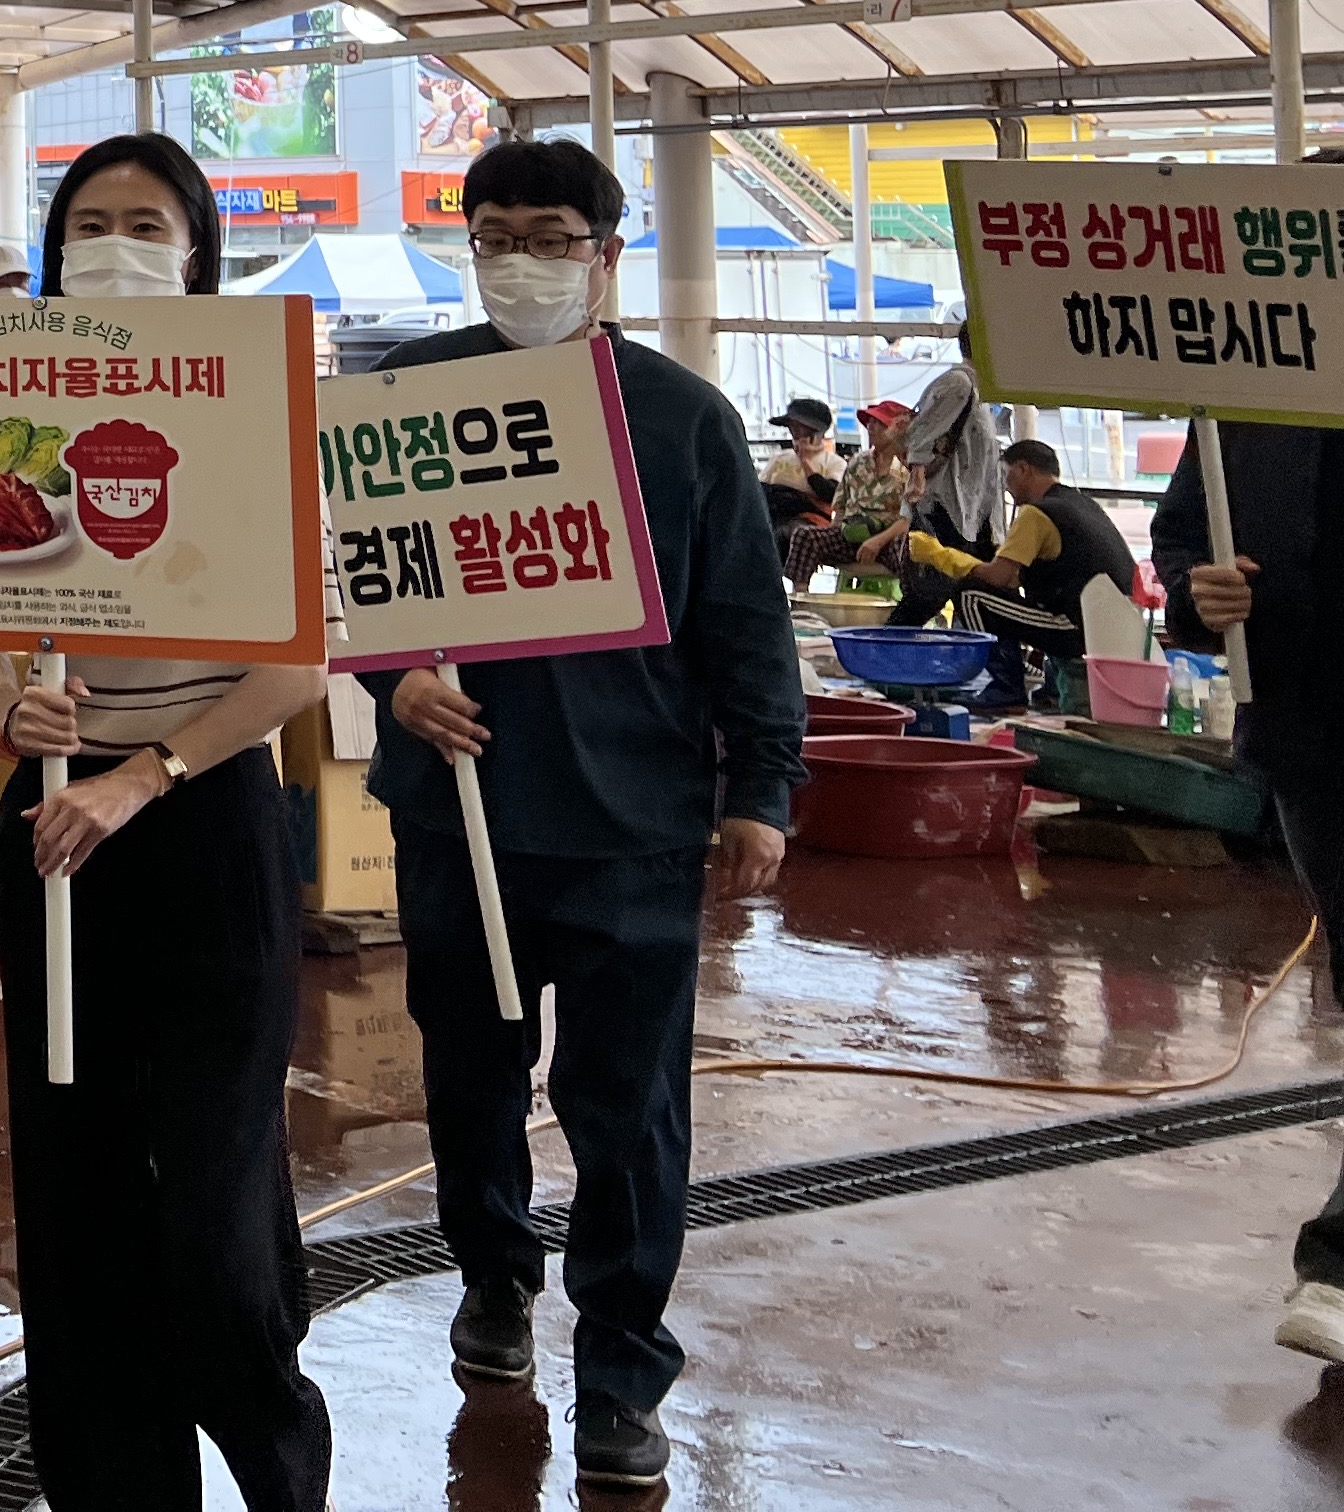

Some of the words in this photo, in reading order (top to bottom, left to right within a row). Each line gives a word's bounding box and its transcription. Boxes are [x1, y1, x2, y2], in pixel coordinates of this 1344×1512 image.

[346, 41, 359, 64] 8
[977, 200, 1071, 269] 부정
[1081, 202, 1226, 275] 상거래
[72, 313, 134, 351] 음식점
[1062, 290, 1160, 362] 하지
[1168, 293, 1317, 372] 맙시다
[85, 478, 157, 508] 국산김치
[339, 519, 445, 607] 경제
[449, 499, 613, 596] 활성화
[55, 587, 77, 598] 100%
[78, 588, 95, 598] 국산
